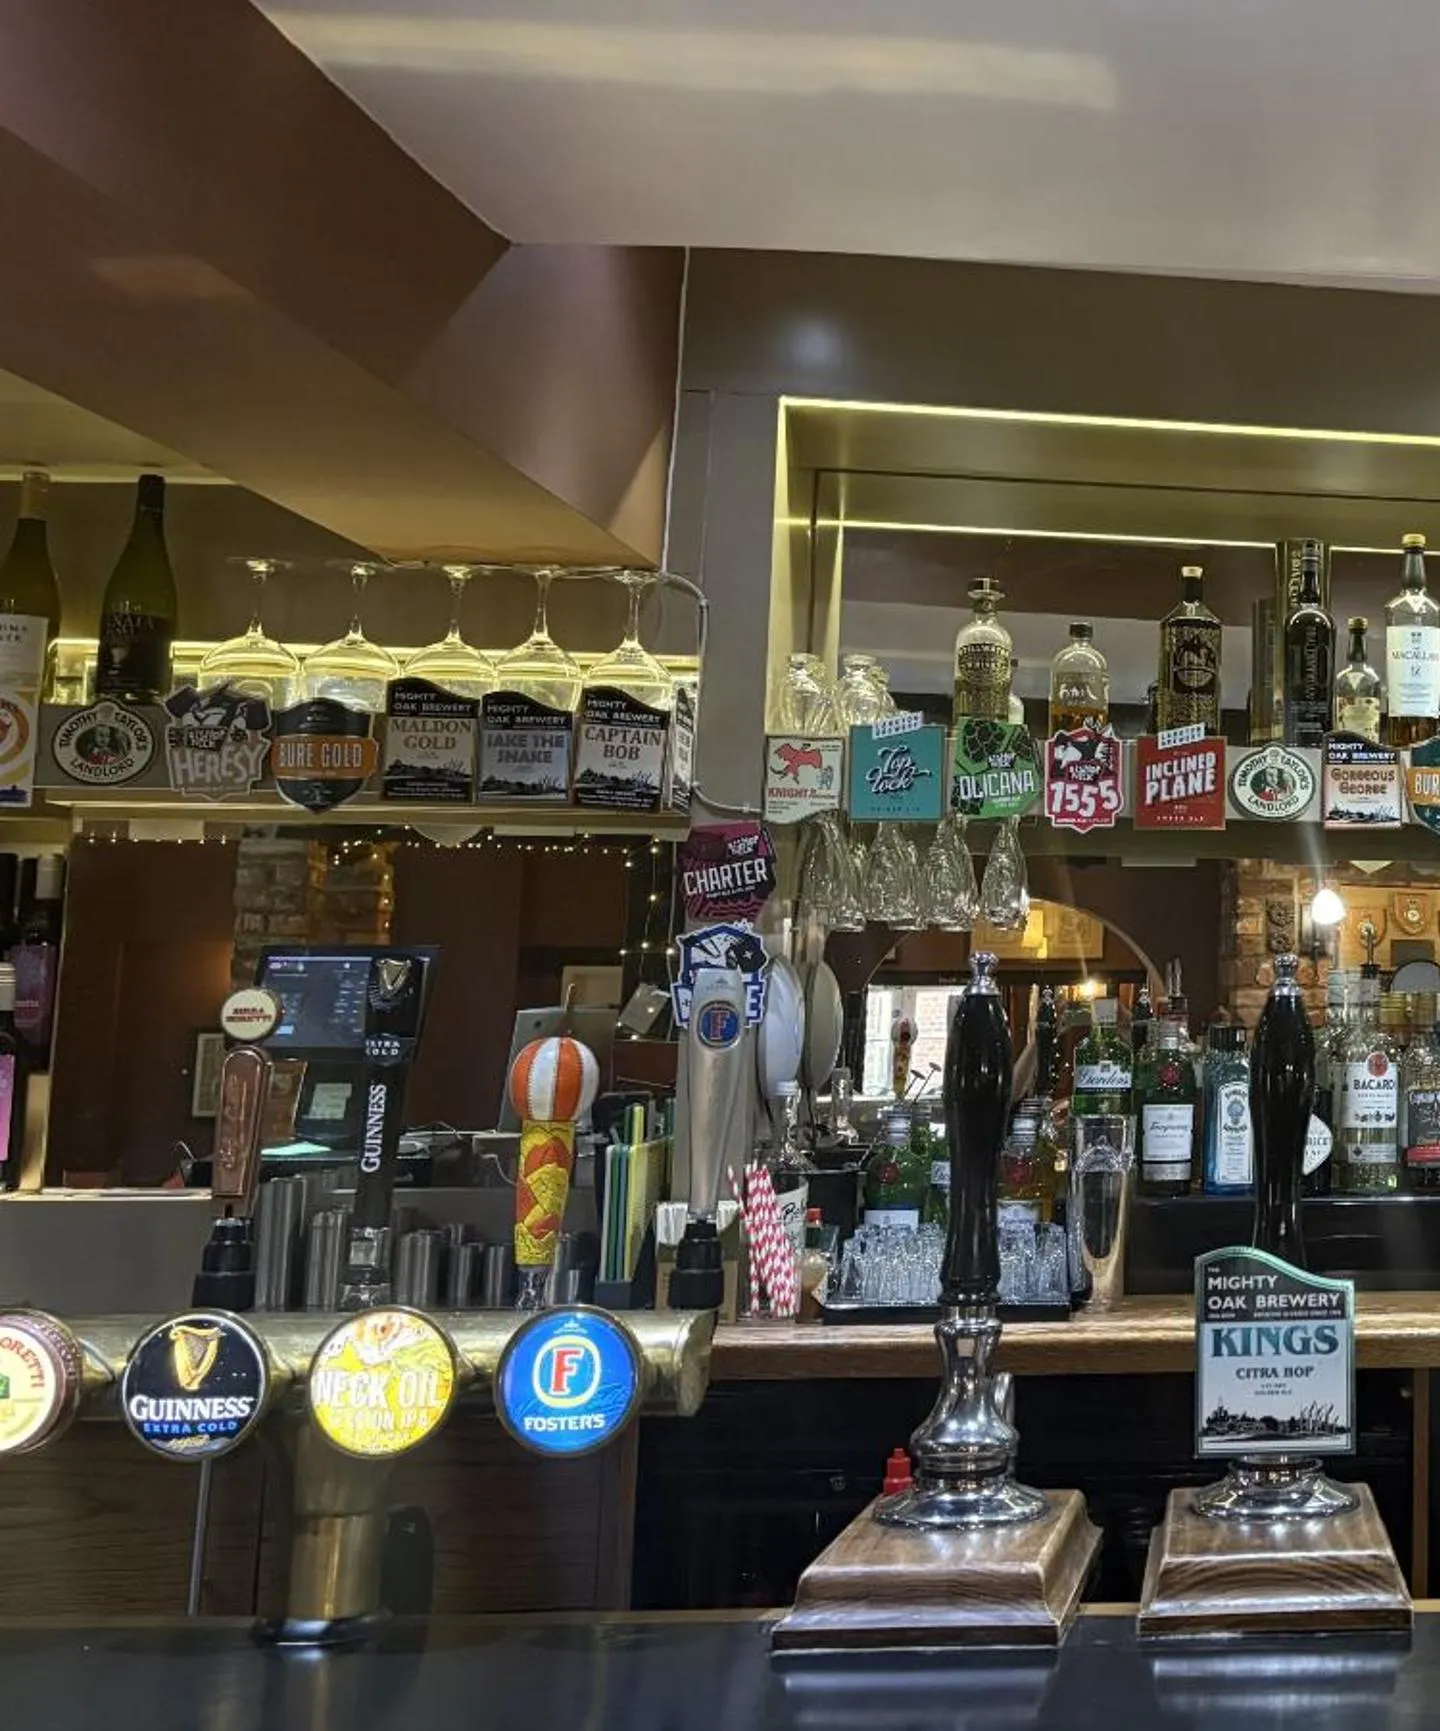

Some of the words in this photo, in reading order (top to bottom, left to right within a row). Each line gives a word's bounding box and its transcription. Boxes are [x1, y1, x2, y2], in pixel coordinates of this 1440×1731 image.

[391, 719, 472, 734] MALDON
[584, 726, 662, 746] CAPTAIN
[403, 735, 457, 750] GOLD
[532, 733, 565, 748] THE
[602, 744, 641, 760] BOB
[70, 756, 136, 778] LANDLORD
[172, 744, 265, 786] HERESY
[321, 742, 363, 768] GOLD
[1145, 751, 1217, 781] INCLINED
[959, 770, 1035, 800] OLICANA
[1145, 769, 1217, 805] PLANE
[1050, 779, 1121, 818] 1555
[1248, 795, 1300, 813] LANDLORD
[683, 857, 769, 897] CHARTER
[360, 1083, 388, 1174] GUINNESS
[1207, 1275, 1278, 1292] MIGHTY
[1207, 1296, 1248, 1310] OAK
[1255, 1293, 1341, 1309] BREWERY
[1210, 1325, 1340, 1358] KINGS
[0, 1336, 46, 1388] ORETTI
[550, 1348, 581, 1397] F
[1235, 1366, 1280, 1380] CITRA
[1283, 1366, 1315, 1379] HOP
[313, 1370, 386, 1408] NECK
[397, 1370, 441, 1408] OIL
[129, 1394, 254, 1421] GUINNESS
[143, 1422, 192, 1434] EXTRA
[196, 1421, 238, 1433] COLD
